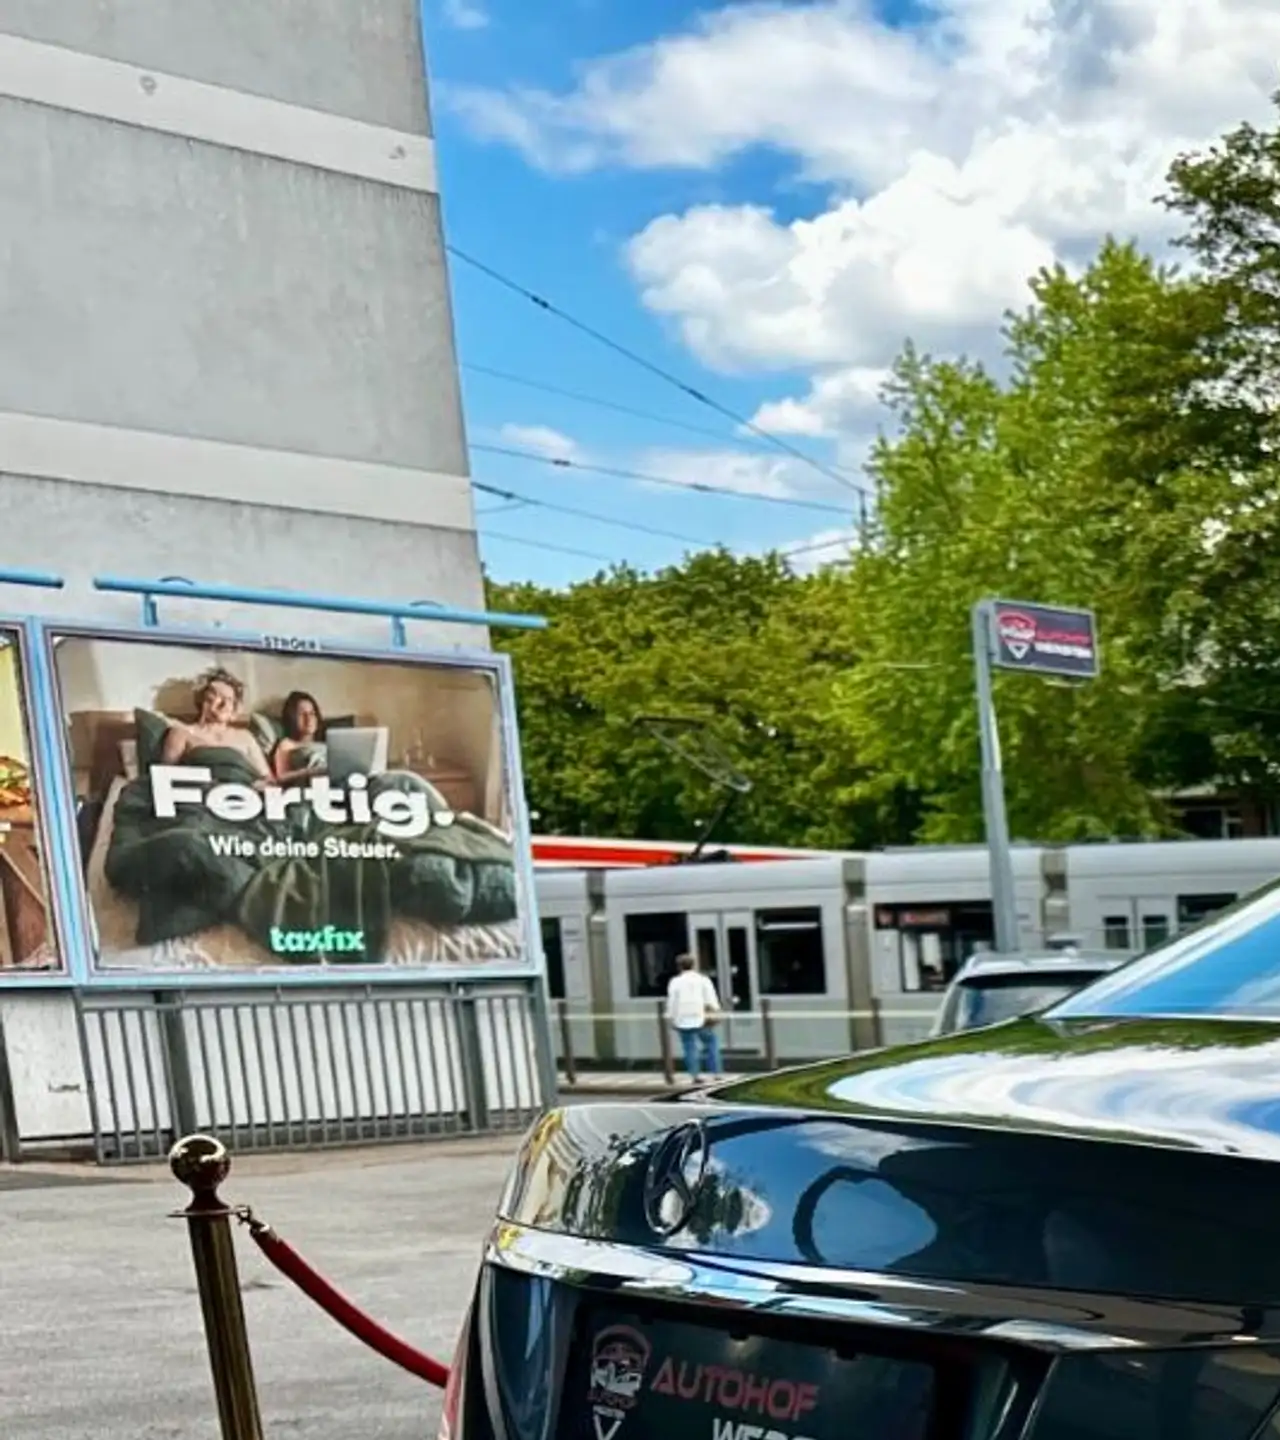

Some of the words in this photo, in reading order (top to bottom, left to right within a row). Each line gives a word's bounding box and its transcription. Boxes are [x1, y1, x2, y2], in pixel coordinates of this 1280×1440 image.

[150, 764, 455, 838] Fertig.
[209, 834, 253, 857] Wie
[259, 836, 319, 858] deine
[323, 837, 404, 860] Steuer.
[650, 1355, 820, 1422] AUTOHOF
